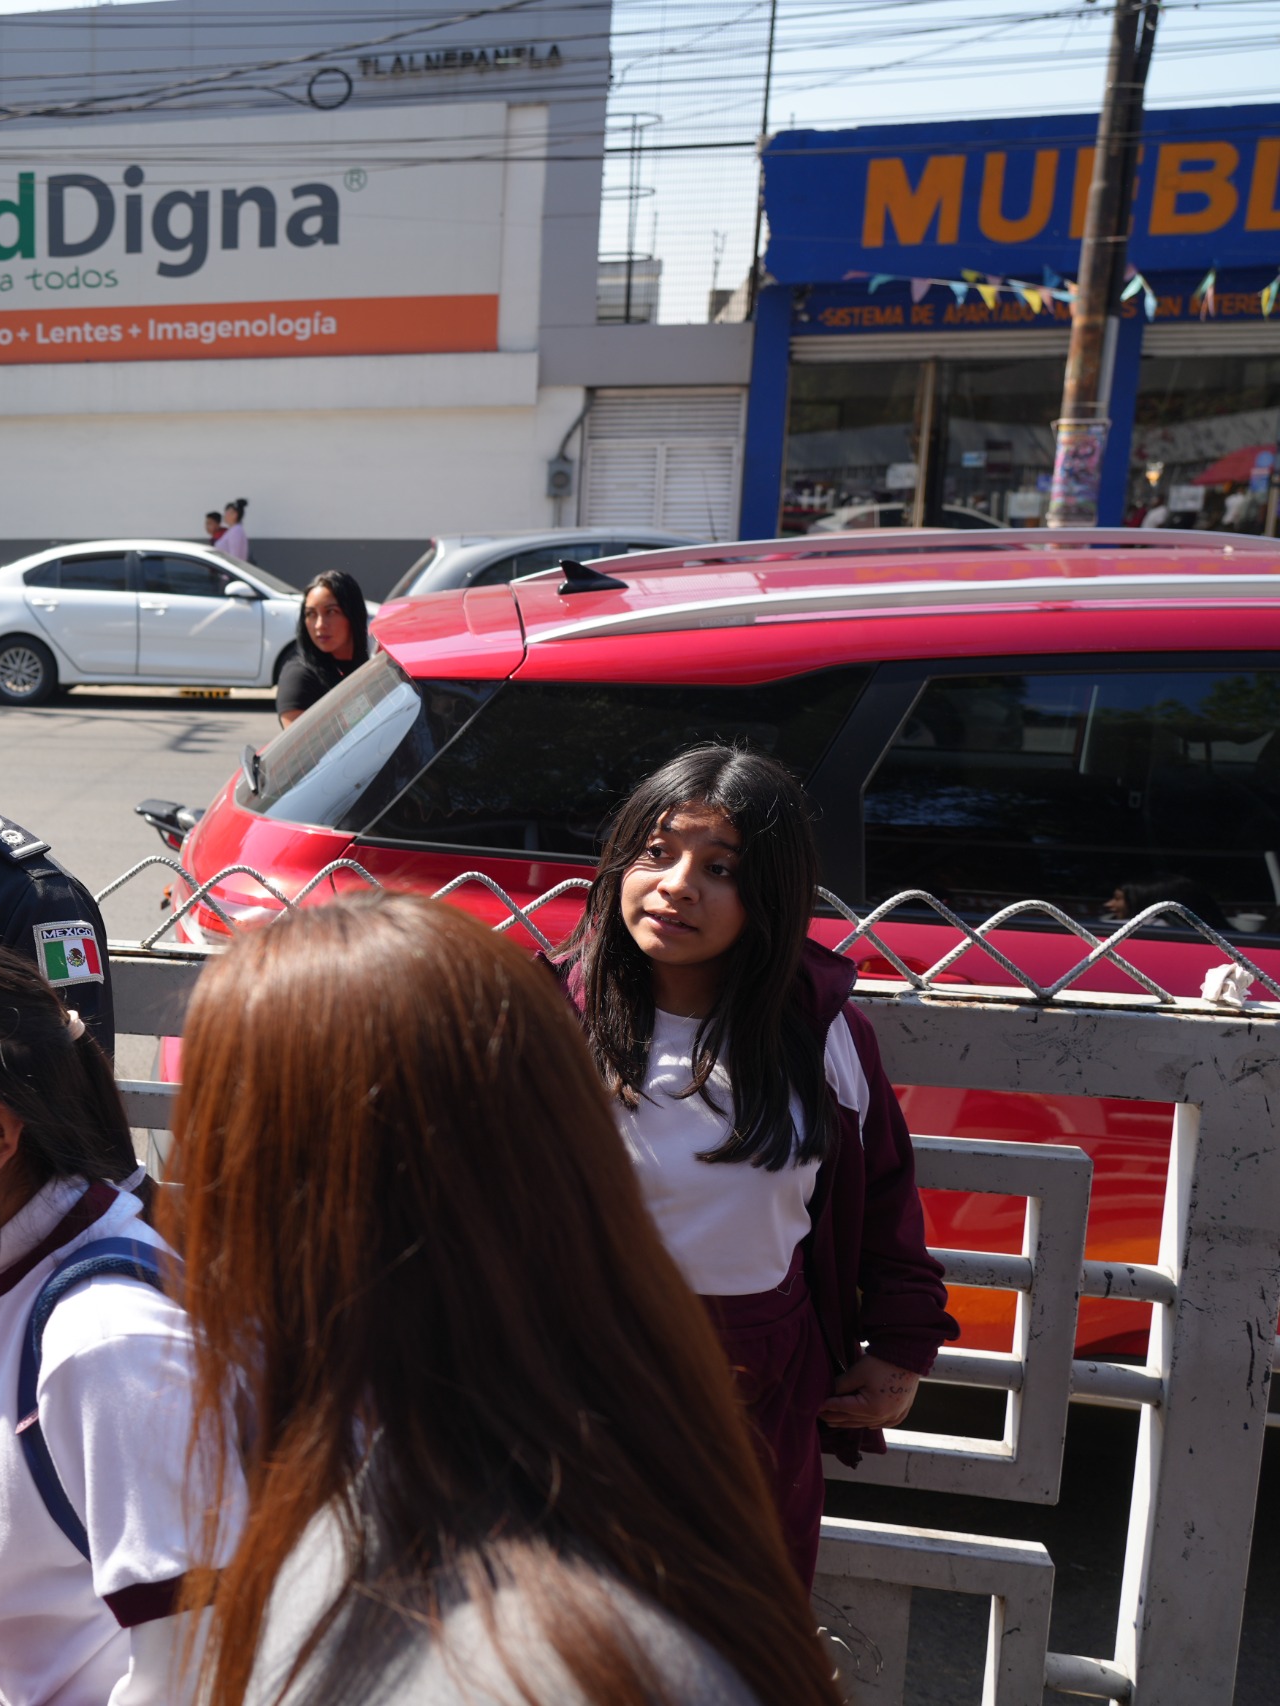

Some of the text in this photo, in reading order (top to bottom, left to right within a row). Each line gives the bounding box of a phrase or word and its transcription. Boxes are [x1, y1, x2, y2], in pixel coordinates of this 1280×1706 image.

[25, 265, 119, 291] todos
[35, 322, 123, 345] Lentes
[148, 311, 338, 344] Imagenología
[42, 928, 94, 940] MEXICO
